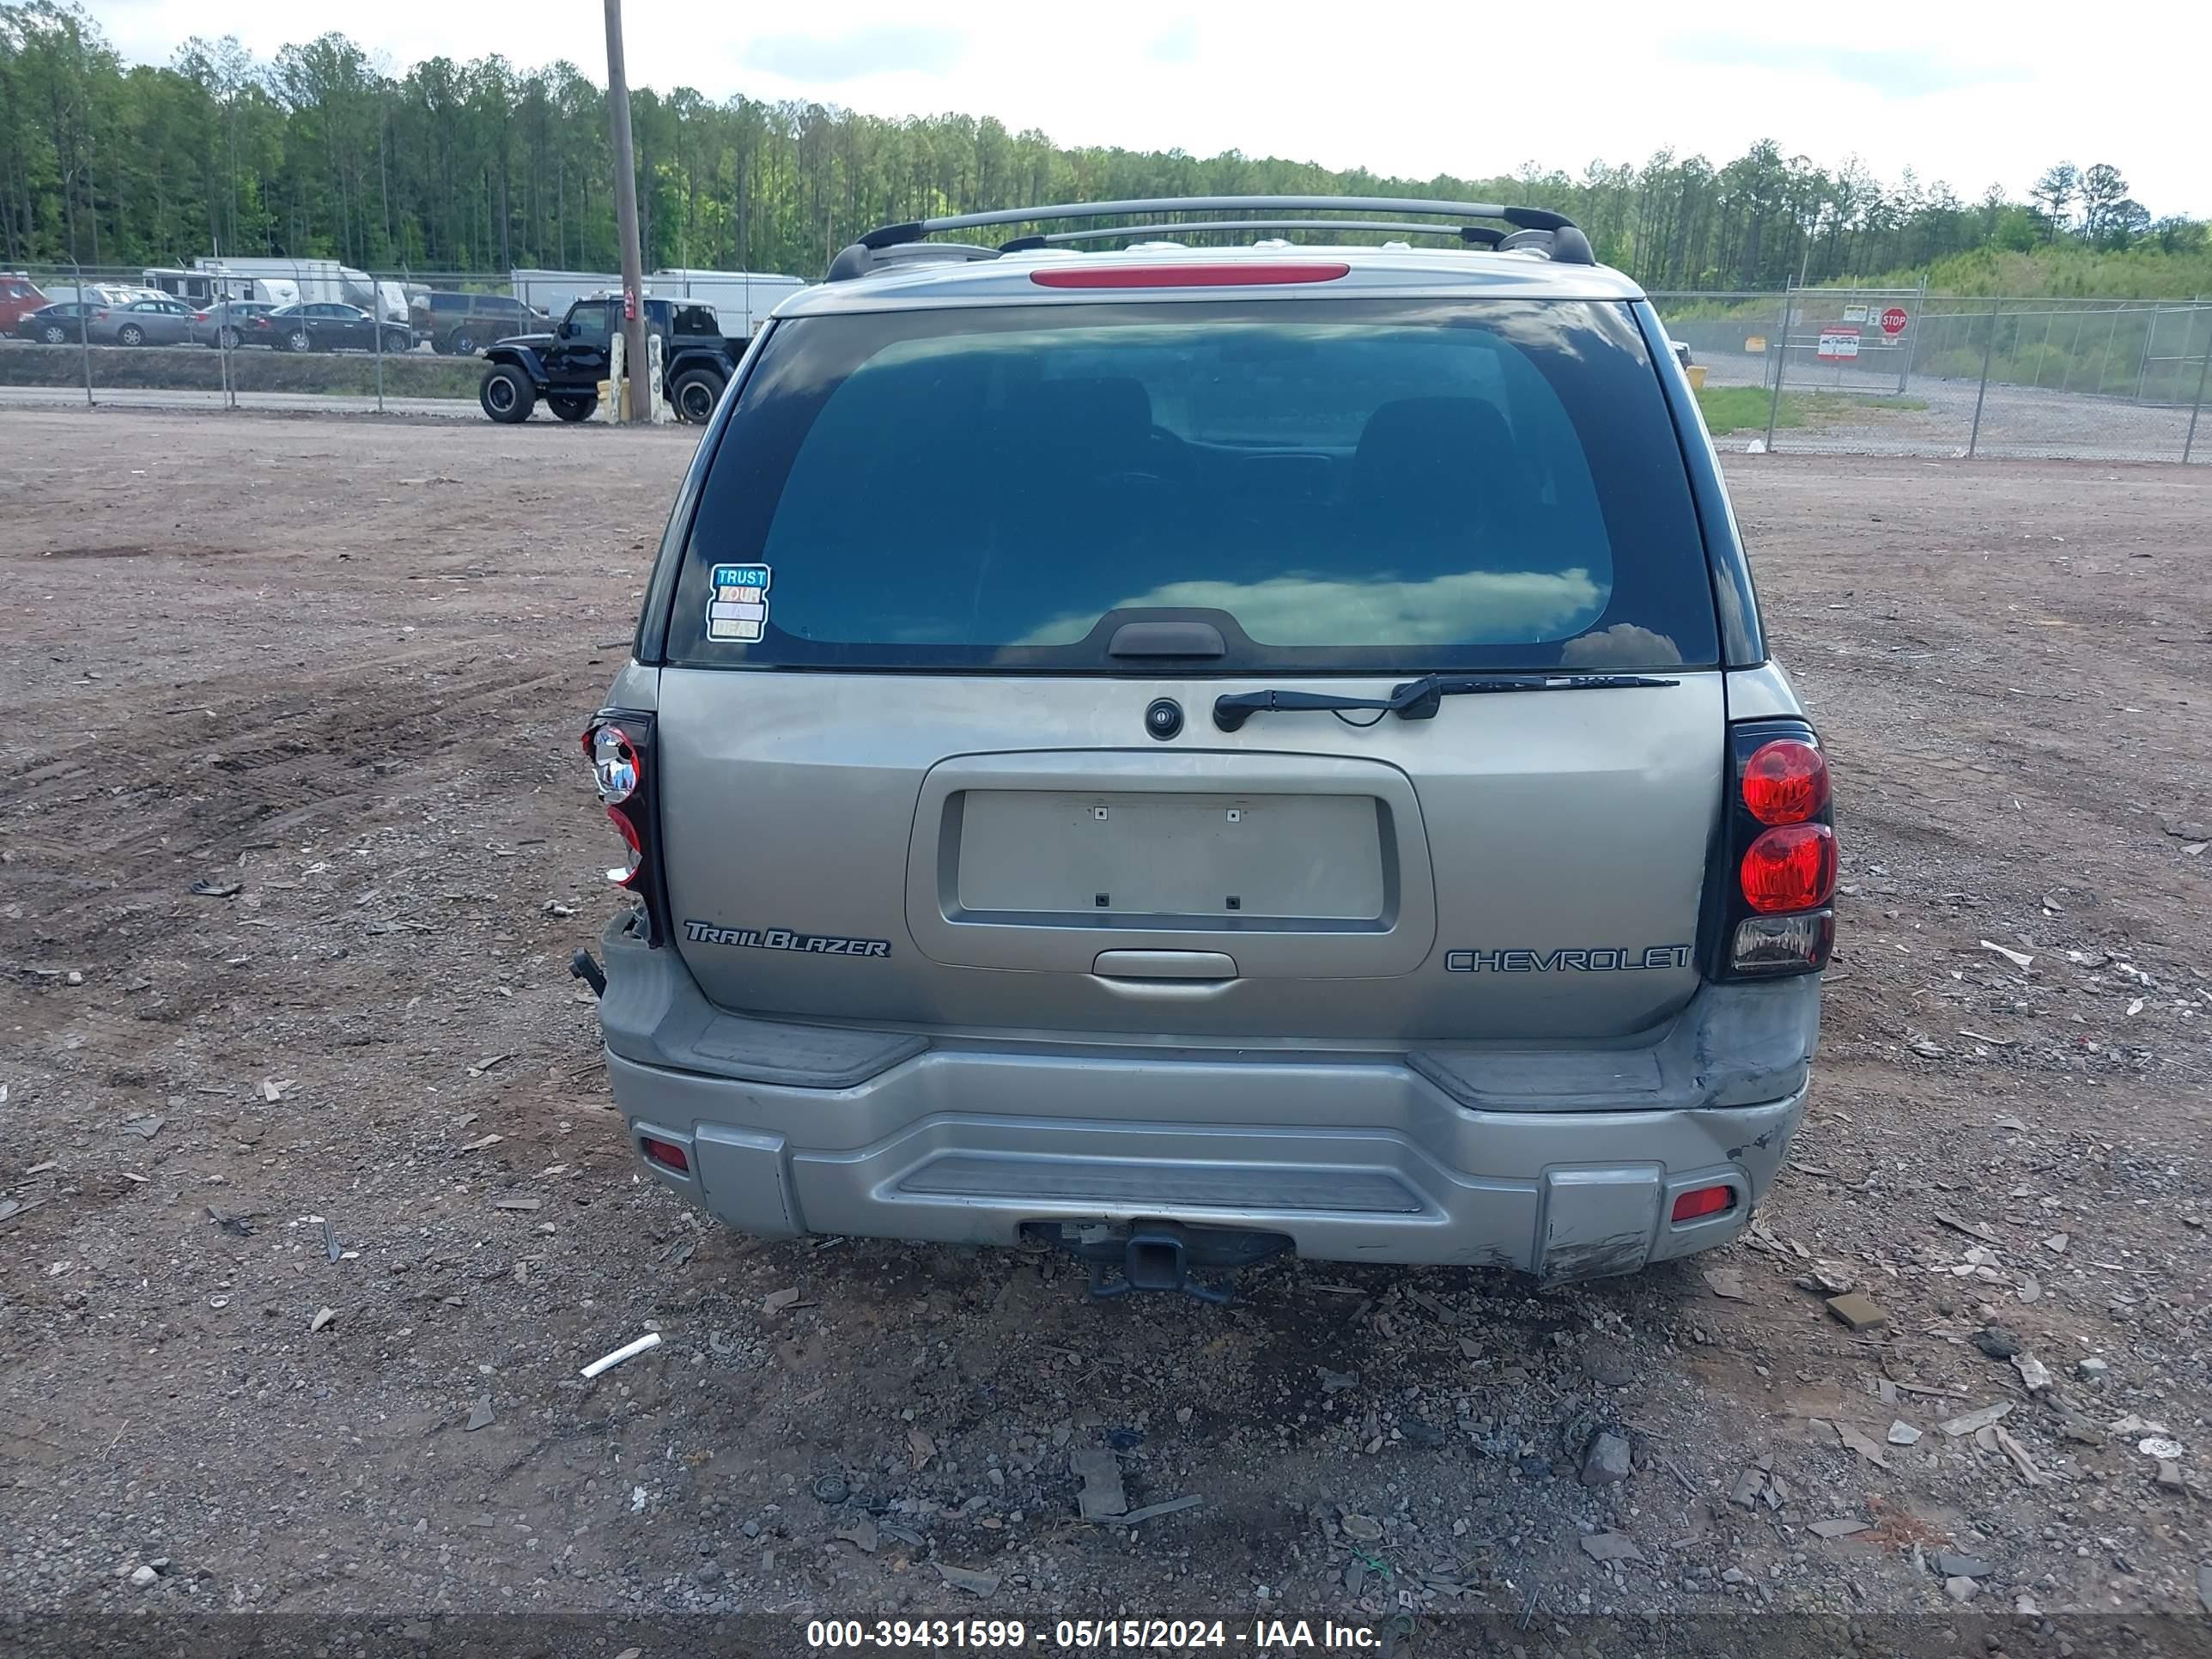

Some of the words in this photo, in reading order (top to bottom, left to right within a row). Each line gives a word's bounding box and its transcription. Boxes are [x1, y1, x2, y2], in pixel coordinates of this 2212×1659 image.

[1882, 315, 1906, 325] STOP
[718, 569, 767, 585] TRUST
[1446, 945, 1692, 972] CHEVROLET
